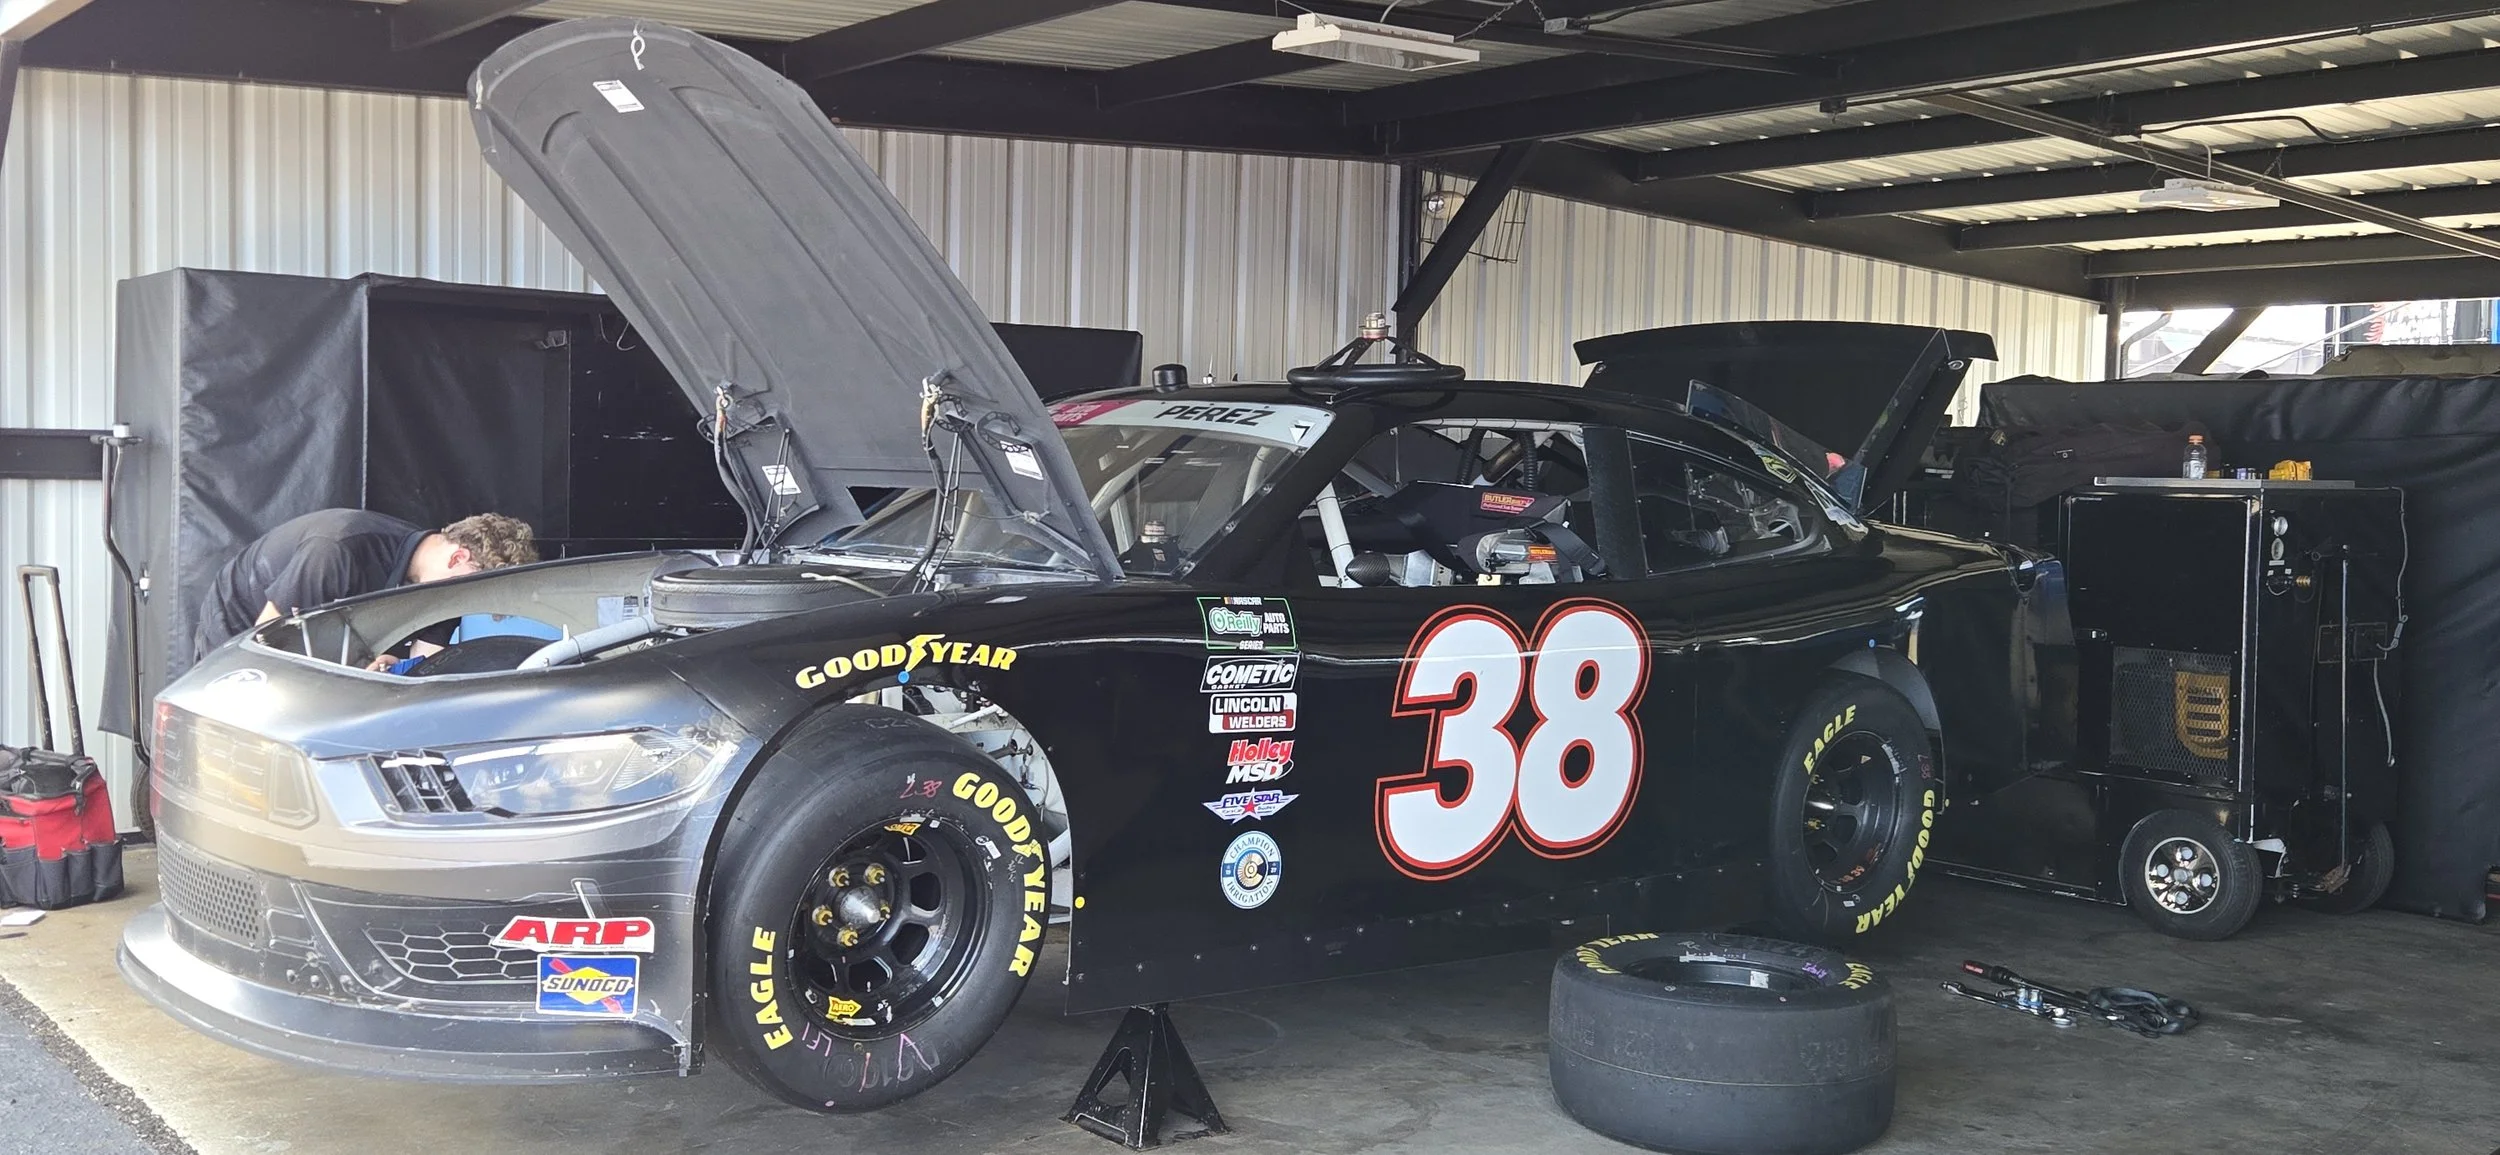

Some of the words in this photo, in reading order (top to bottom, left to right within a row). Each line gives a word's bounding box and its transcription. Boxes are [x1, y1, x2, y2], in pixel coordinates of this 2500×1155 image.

[1154, 405, 1276, 427] PEREZ
[1232, 597, 1262, 605] NASCAR
[1211, 608, 1261, 635] O'Reilly
[1263, 623, 1290, 634] PARTS
[1264, 612, 1285, 622] AUTO
[1239, 640, 1264, 650] SERIES
[795, 634, 1017, 689] GOODYEAR
[1206, 663, 1295, 685] COMETIC
[1215, 697, 1281, 713] LINCOLN
[1229, 715, 1287, 729] WELDERS
[1382, 603, 1647, 872] 38
[1804, 704, 1857, 775] EAGLE
[1228, 738, 1295, 766] Holley
[1225, 760, 1284, 784] MSD
[1222, 796, 1249, 808] FIVE
[1254, 793, 1280, 803] STAR
[1230, 837, 1275, 860] CHAMPION
[1856, 790, 1935, 934] GOODYEAR
[952, 772, 1046, 977] GOODYEAR
[1227, 877, 1274, 904] IRRIGATION
[502, 919, 651, 945] ARP
[547, 977, 630, 993] SUNOCO
[750, 926, 794, 1050] EAGLE
[831, 1002, 856, 1012] AERO
